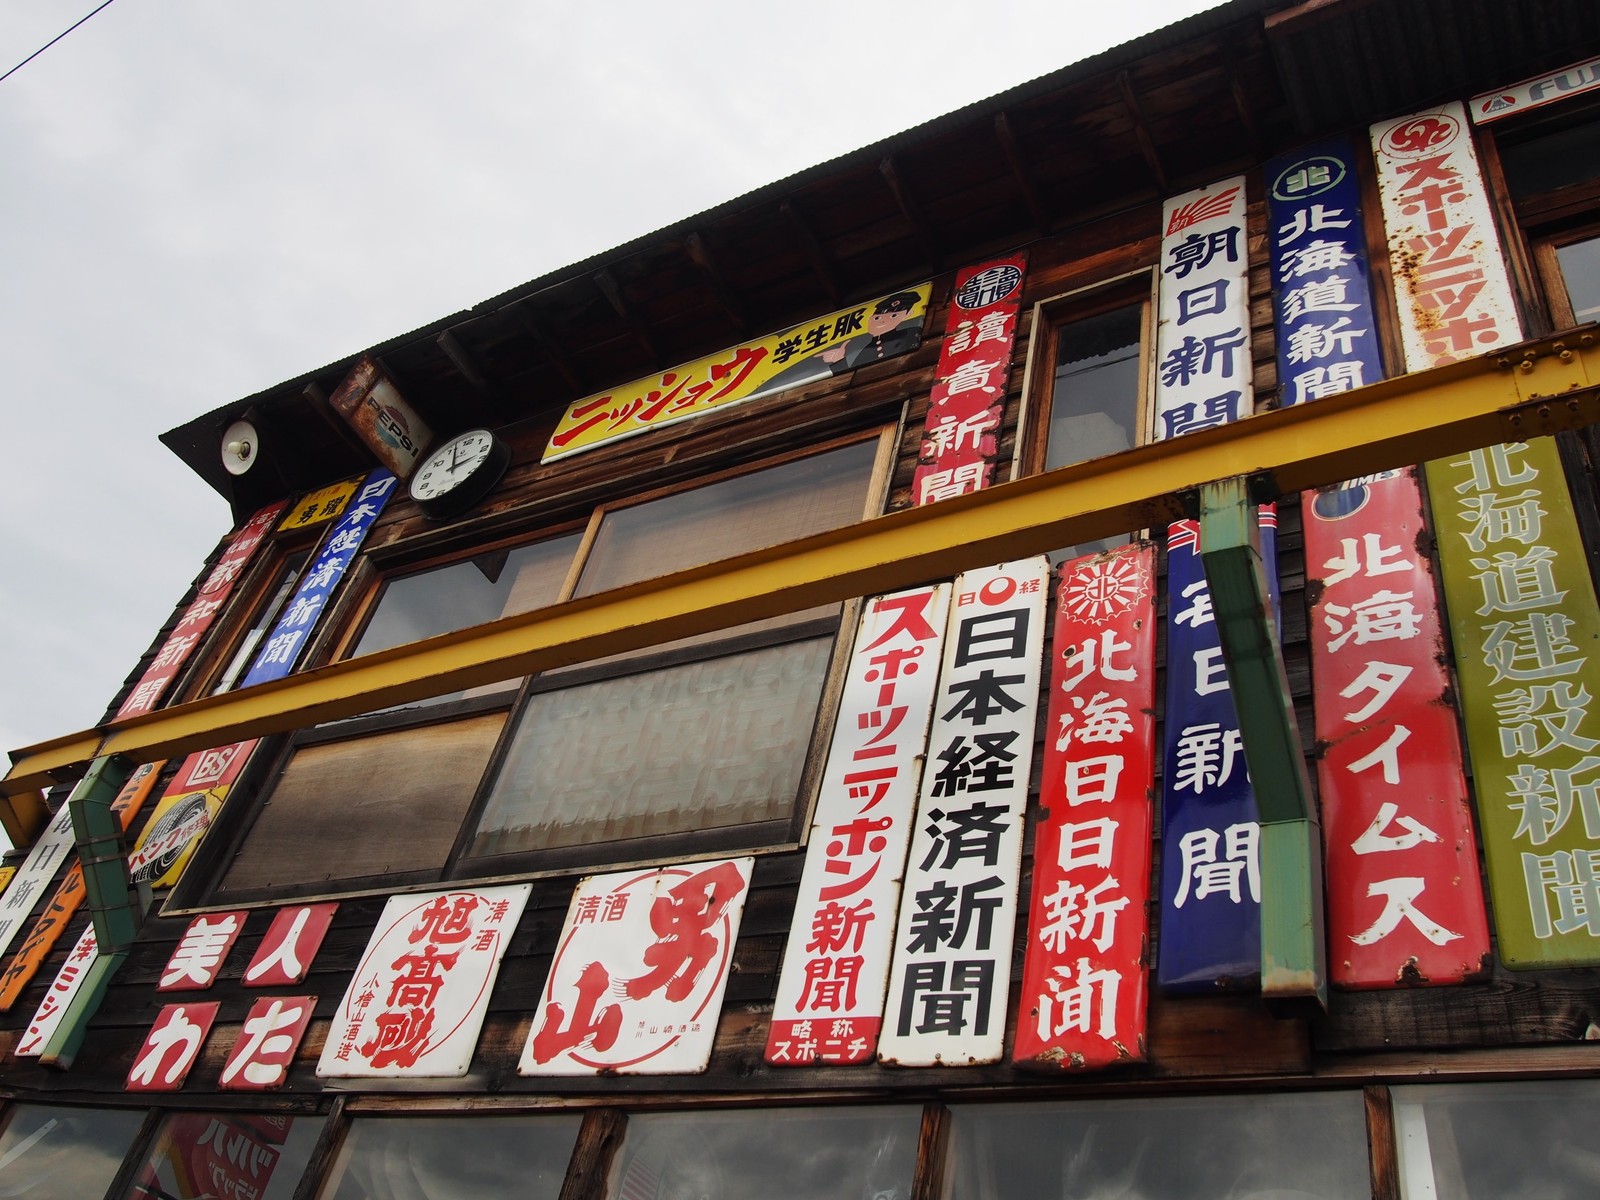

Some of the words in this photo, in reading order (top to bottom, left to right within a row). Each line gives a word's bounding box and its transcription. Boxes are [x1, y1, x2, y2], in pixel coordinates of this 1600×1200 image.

[1159, 225, 1248, 441] 朝日新聞
[1278, 203, 1368, 407] 北海道新聞
[1394, 152, 1499, 368] スポーツニッポ
[366, 396, 420, 458] PEPSI
[433, 460, 445, 468] 10
[551, 345, 769, 449] ニッショウ
[771, 307, 866, 364] 学生服
[422, 472, 433, 481] 9
[117, 556, 246, 717] 報知新聞
[1448, 442, 1600, 939] 北海道建設新聞
[194, 747, 234, 779] BS
[794, 592, 940, 1013] スポーツニッポン新聞
[896, 607, 1029, 1038] 日本経済新聞
[1322, 533, 1465, 947] 北海タイムス
[1036, 629, 1138, 1044] 北海日日新聞
[18, 928, 98, 1054] 洋ミシン
[533, 861, 745, 1065] 男山
[771, 1036, 867, 1061] スポニチ
[790, 1019, 854, 1039] 略称
